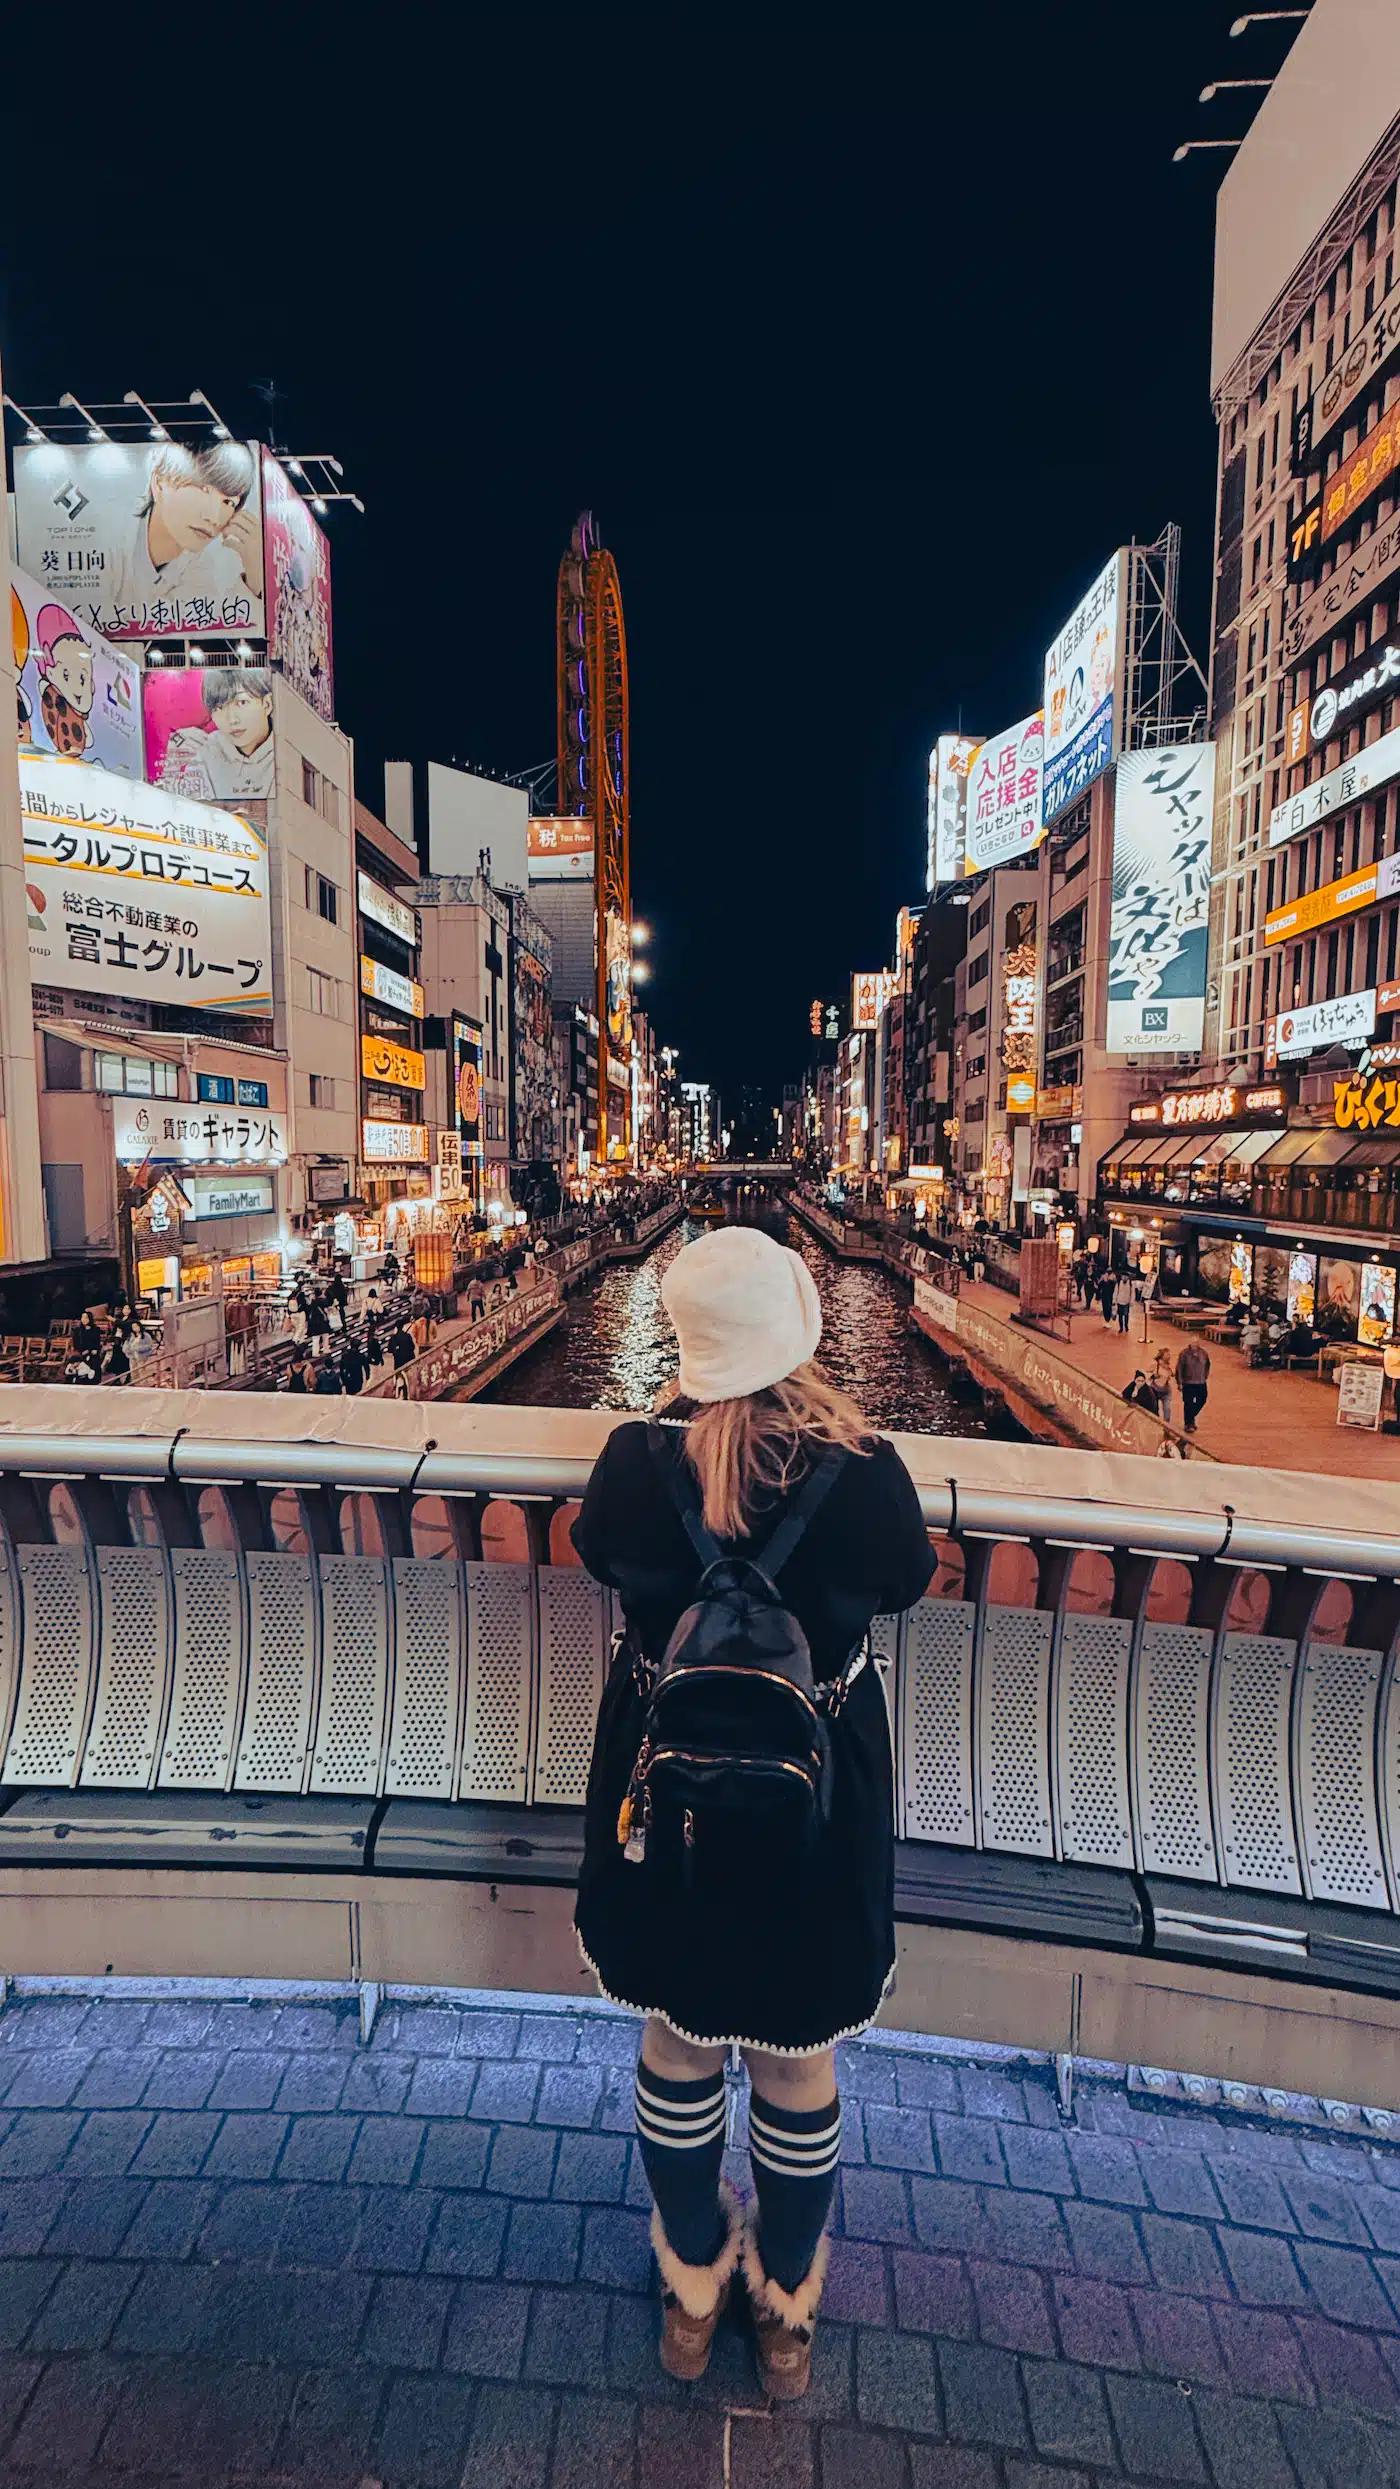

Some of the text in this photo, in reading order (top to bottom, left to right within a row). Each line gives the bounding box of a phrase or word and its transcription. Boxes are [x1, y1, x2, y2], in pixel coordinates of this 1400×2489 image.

[1328, 420, 1400, 520] 個室肉
[1292, 507, 1320, 562] 7F
[1291, 711, 1303, 759] 5F
[977, 742, 1018, 791] 入店
[1044, 733, 1108, 820] ガルフネット
[976, 767, 1039, 822] 応援金
[1292, 766, 1357, 831] 白木屋
[63, 890, 199, 939] 総合不動産業の
[65, 922, 264, 989] 富士グループ
[1144, 1011, 1166, 1026] BX
[1266, 1024, 1276, 1064] 2F
[1370, 1045, 1400, 1065] ハン
[208, 1079, 218, 1099] 酒
[1245, 1089, 1282, 1109] COFFEE
[163, 1113, 279, 1149] 賃貸のギャラント
[440, 1134, 458, 1166] 伝串
[440, 1167, 459, 1190] 50
[209, 1192, 261, 1211] FamilyMart
